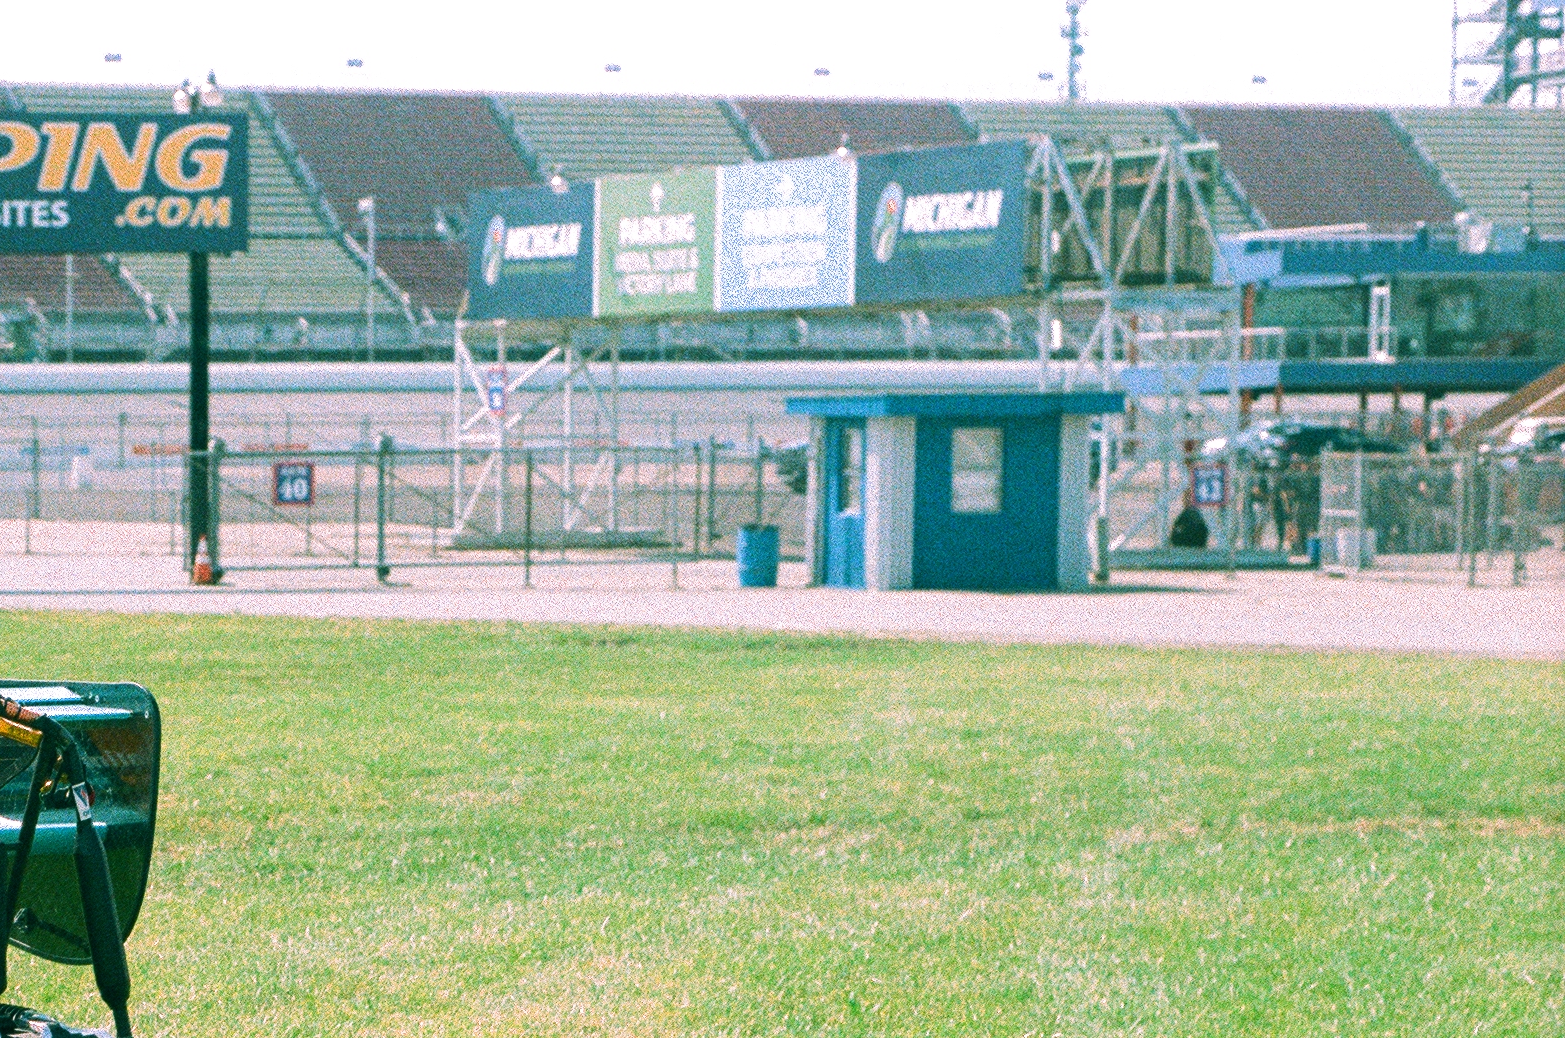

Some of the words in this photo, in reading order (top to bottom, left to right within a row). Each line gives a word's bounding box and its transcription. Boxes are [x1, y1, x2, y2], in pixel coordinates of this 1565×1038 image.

[115, 196, 231, 228] .COM
[902, 188, 1003, 233] MICHIGAN
[504, 222, 582, 260] MICHIGAN
